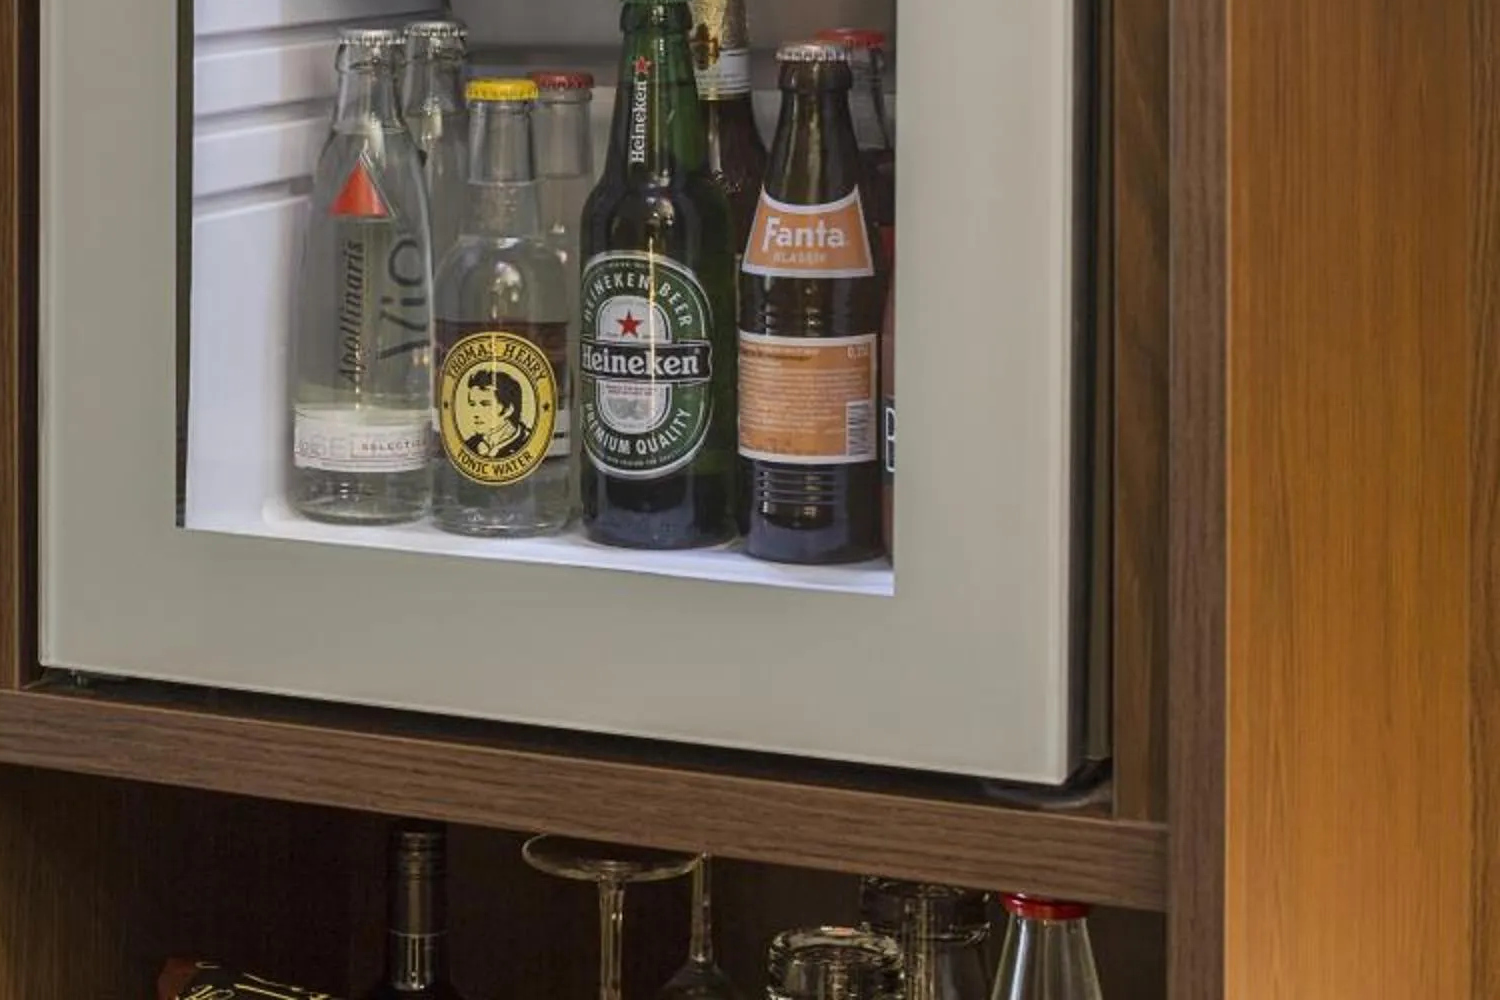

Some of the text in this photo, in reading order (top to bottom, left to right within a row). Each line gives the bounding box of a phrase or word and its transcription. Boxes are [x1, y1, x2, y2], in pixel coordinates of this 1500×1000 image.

[631, 80, 649, 164] Heineken
[762, 216, 846, 251] Fanta
[338, 239, 367, 384] Apollinaris
[583, 272, 693, 328] HEINEKEN BEER
[449, 341, 547, 379] THOMAS HENRY
[581, 343, 700, 376] Heineken
[585, 402, 692, 456] PREMIUM QUALITY
[457, 449, 533, 475] TONIC WATER
